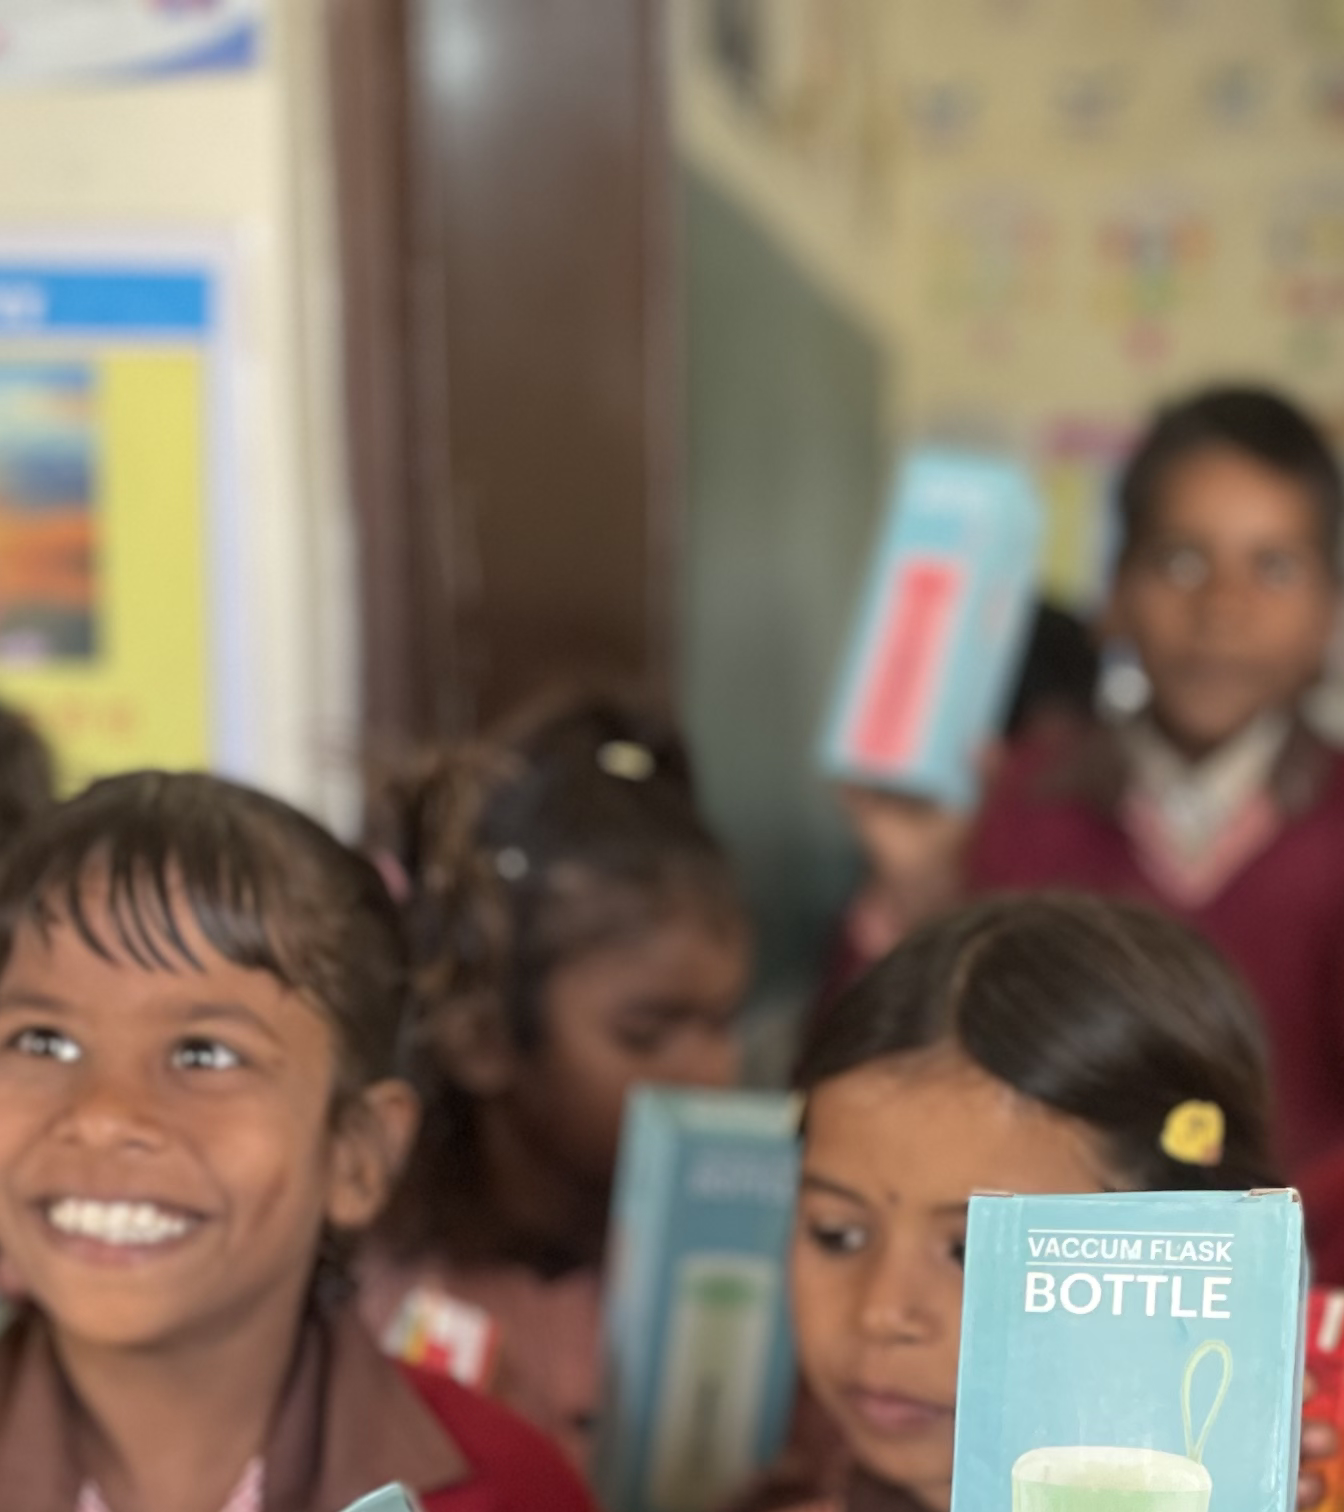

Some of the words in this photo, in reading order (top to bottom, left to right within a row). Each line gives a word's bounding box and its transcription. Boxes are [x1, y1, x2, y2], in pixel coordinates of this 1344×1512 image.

[1027, 1236, 1143, 1260] VACCUM
[1150, 1239, 1235, 1263] FLASK
[1024, 1271, 1233, 1319] BOTTLE
